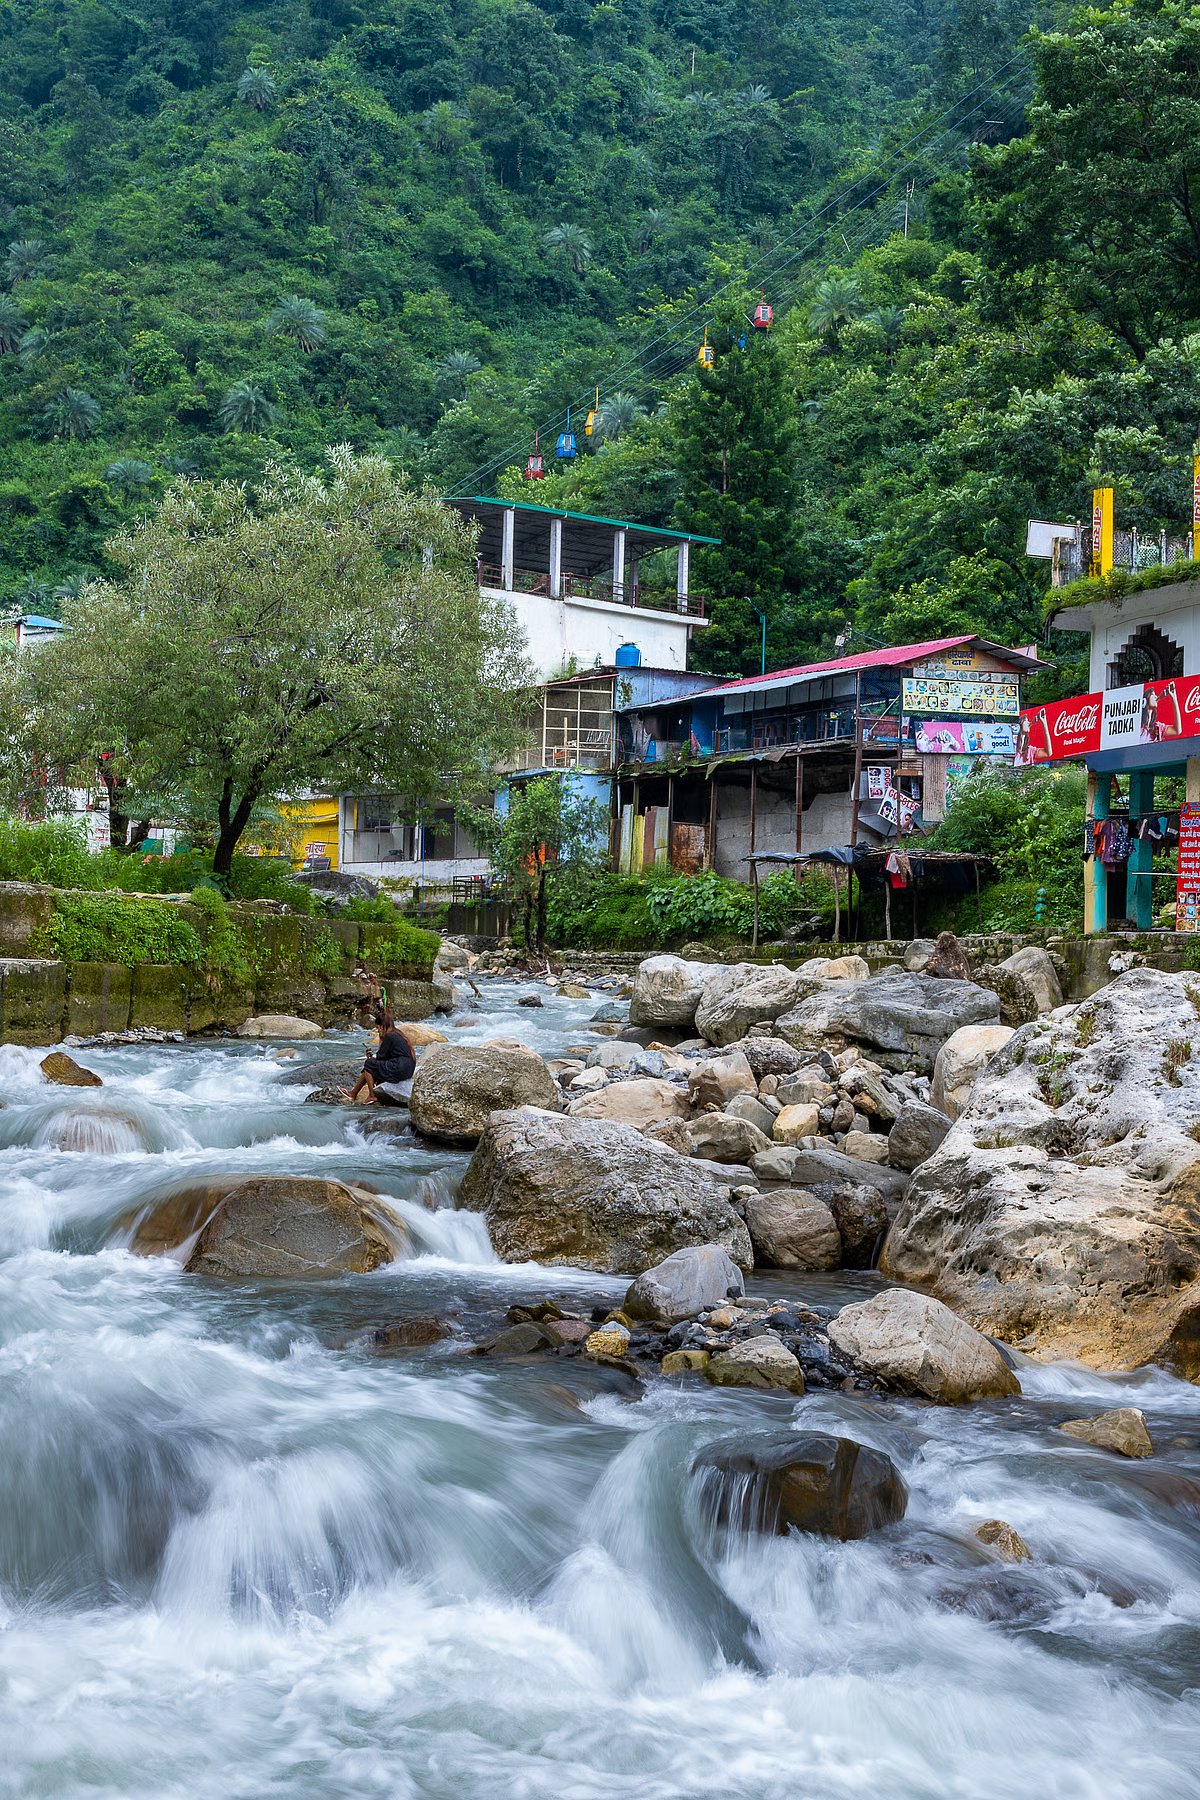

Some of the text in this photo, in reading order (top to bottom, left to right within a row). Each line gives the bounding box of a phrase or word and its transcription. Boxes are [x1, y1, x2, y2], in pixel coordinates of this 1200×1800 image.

[1104, 698, 1141, 719] PUNJABI
[1053, 703, 1100, 737] Coca-Cola
[1108, 717, 1134, 736] TADKA
[991, 739, 1010, 749] good!
